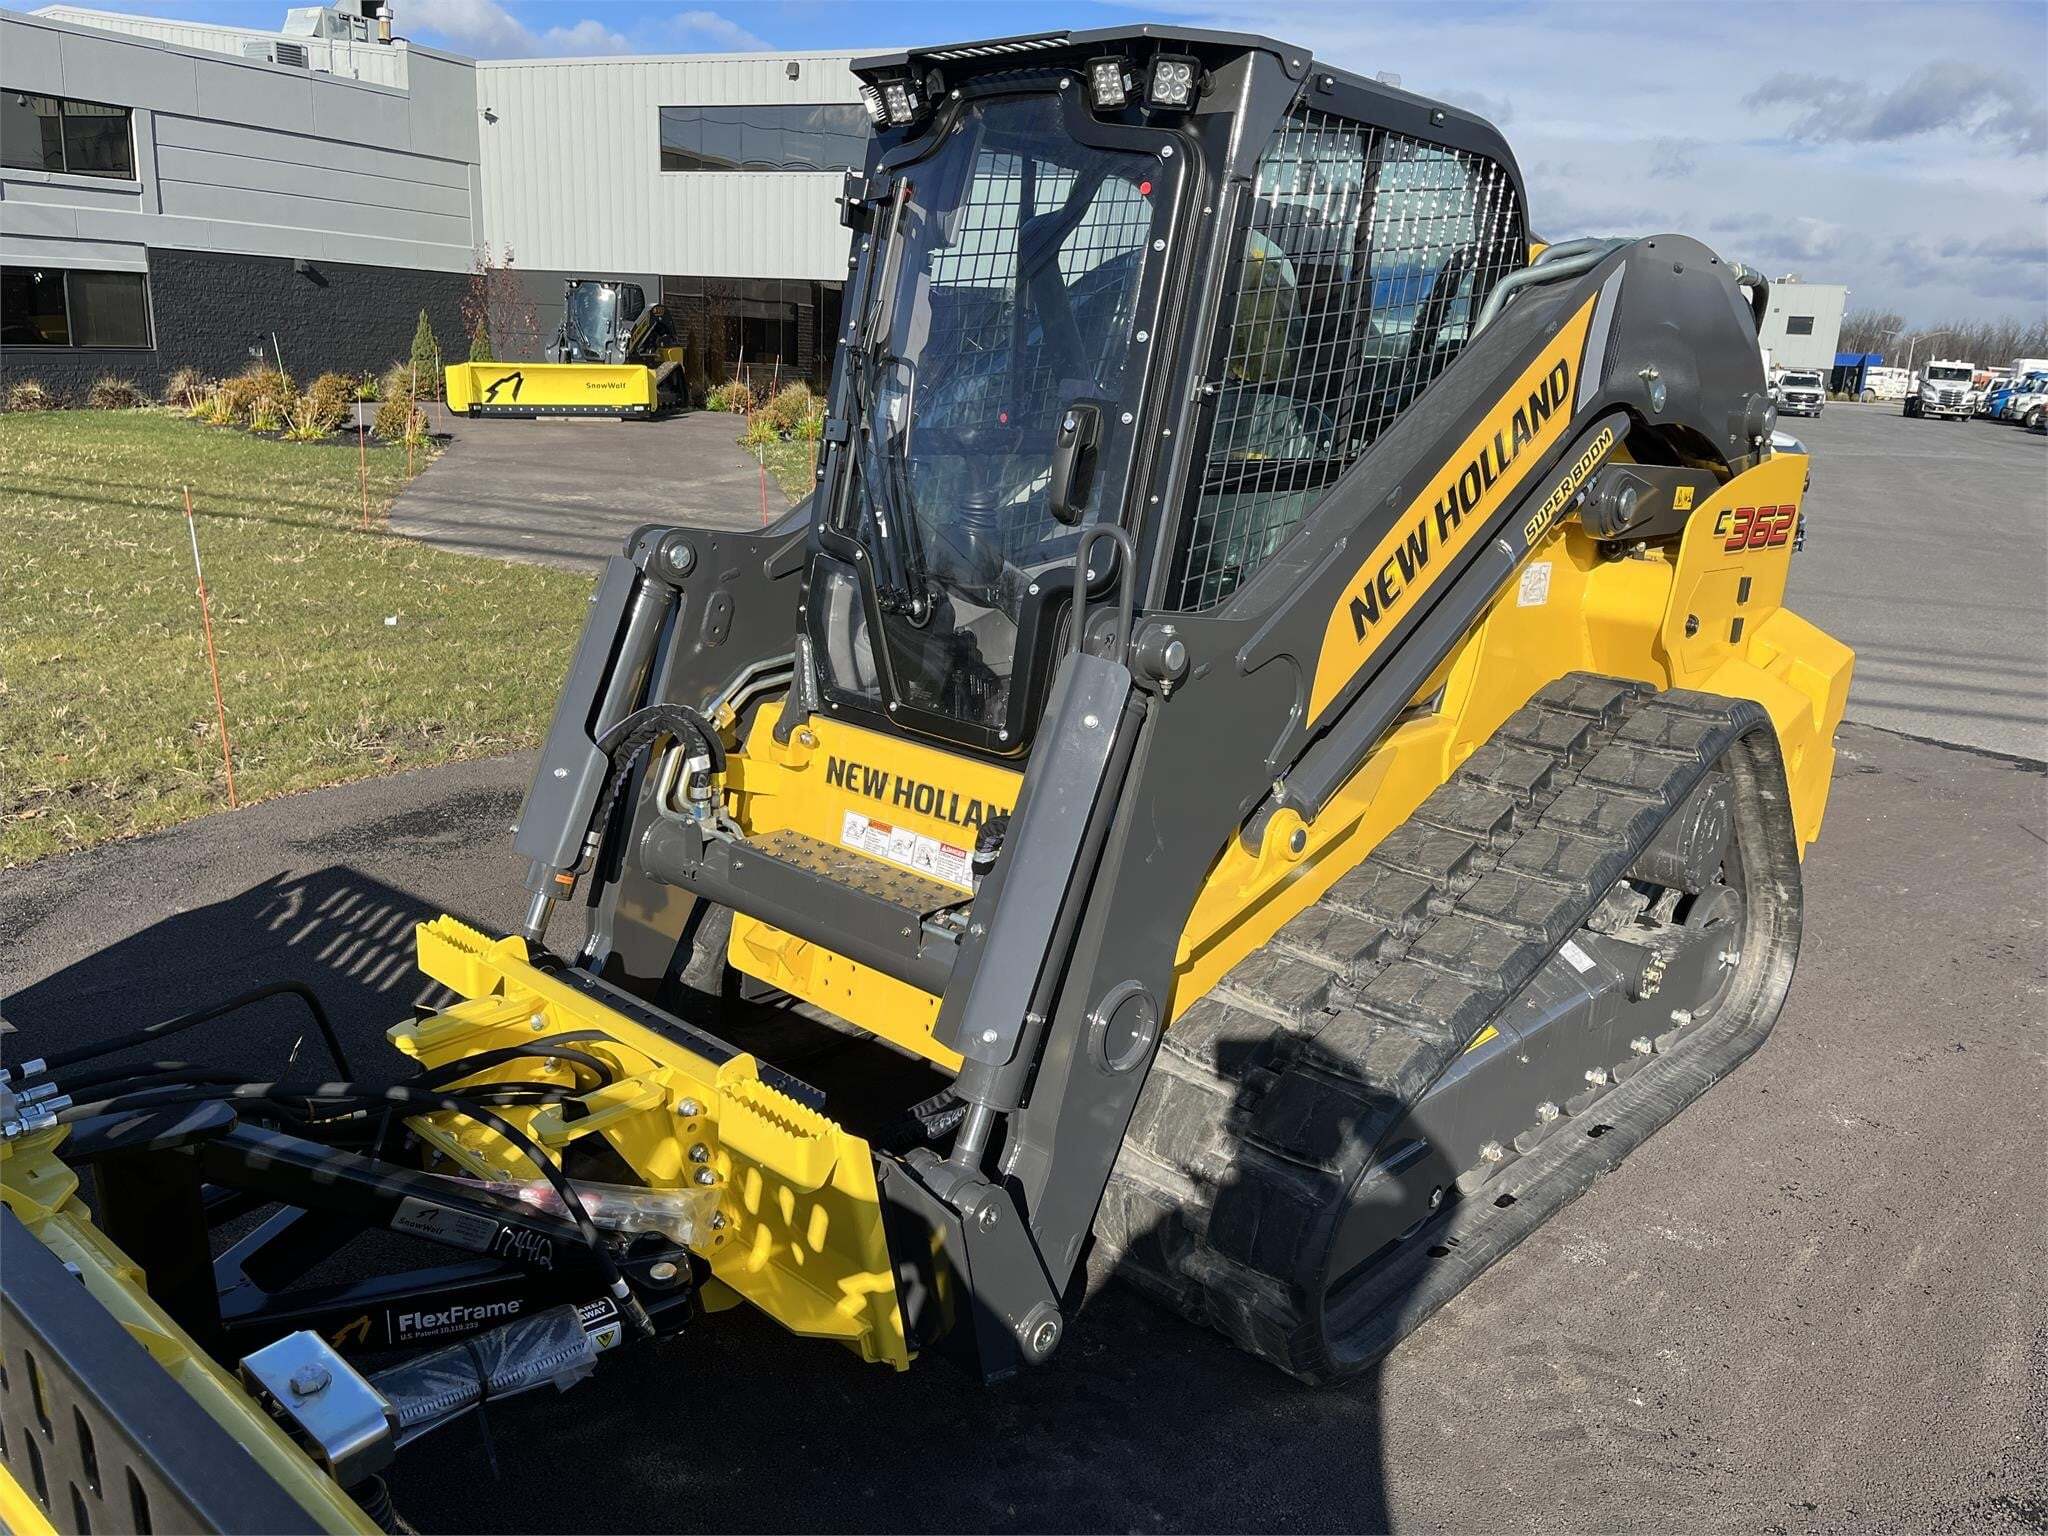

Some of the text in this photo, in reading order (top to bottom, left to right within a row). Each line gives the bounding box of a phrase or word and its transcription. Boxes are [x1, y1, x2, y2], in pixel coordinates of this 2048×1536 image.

[585, 381, 627, 390] SnowWolf
[1348, 357, 1571, 645] NEW HOLLAND
[1525, 430, 1613, 540] SUPER BOOM
[1713, 504, 1796, 552] C362
[825, 756, 1013, 830] NEW HOLLAN
[398, 1300, 521, 1332] FlexFrame
